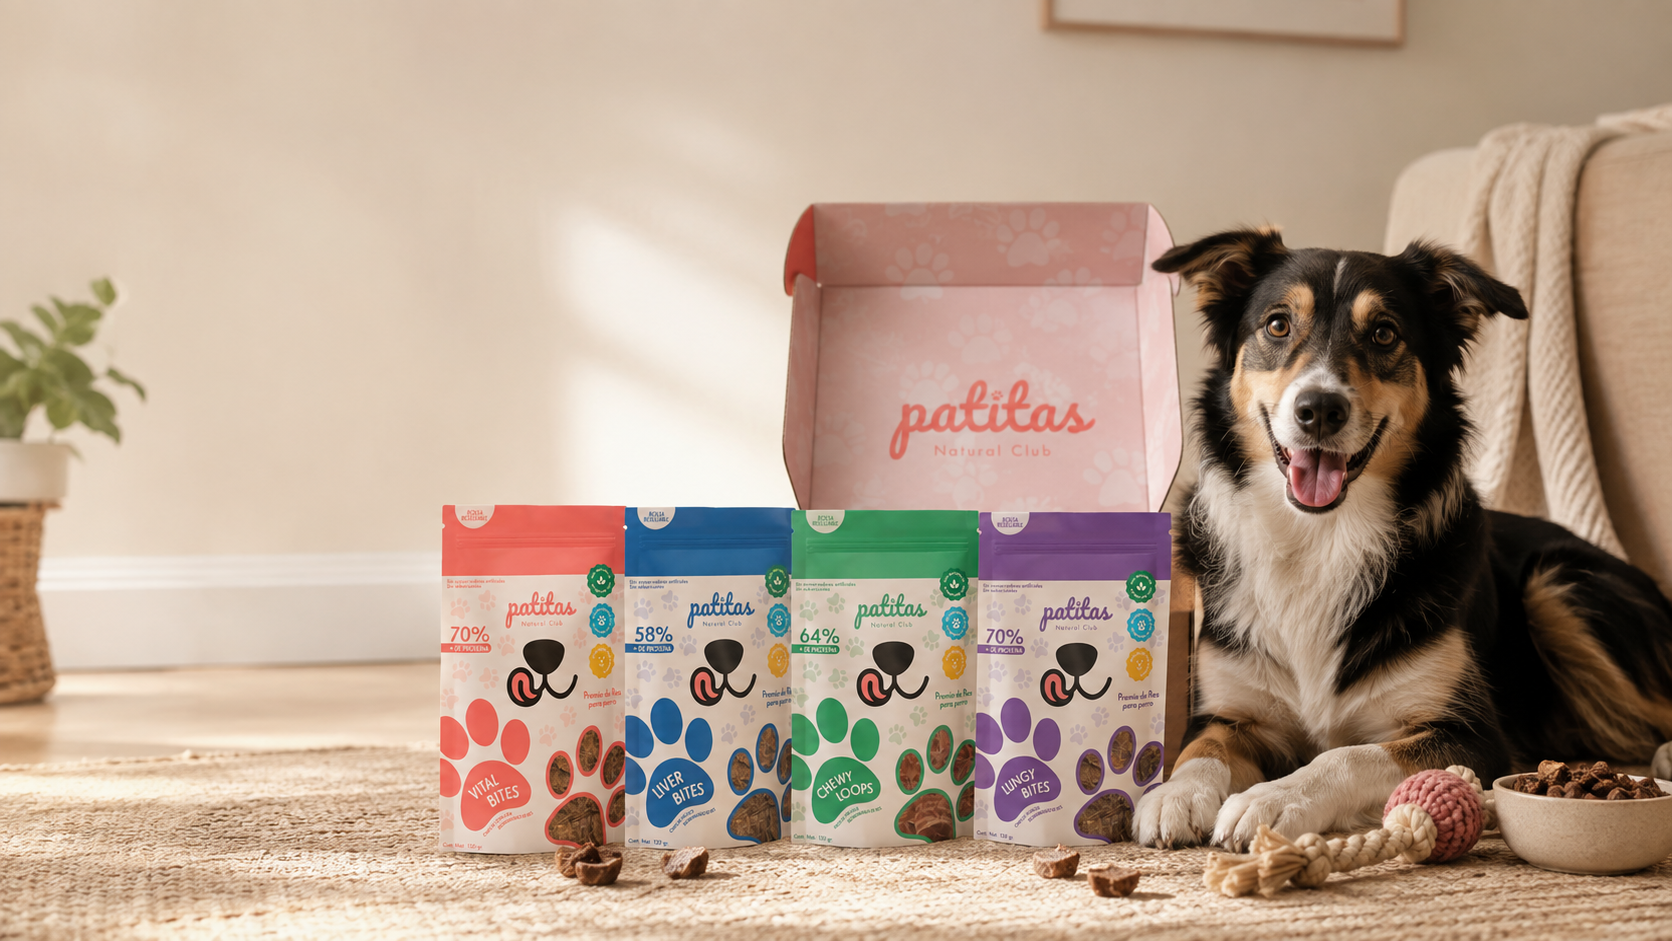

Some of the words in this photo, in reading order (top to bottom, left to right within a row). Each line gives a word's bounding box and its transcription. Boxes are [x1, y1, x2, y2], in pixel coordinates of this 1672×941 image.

[889, 379, 1096, 460] patitas
[934, 444, 1001, 457] Natural
[1011, 444, 1051, 457] Club
[505, 590, 577, 629] patitas
[686, 591, 755, 629] patitas
[854, 593, 927, 630] patitas
[1039, 596, 1113, 632] patitas
[450, 626, 490, 642] 70%
[634, 626, 673, 643] 58%
[799, 628, 840, 644] 64%
[985, 628, 1024, 645] 70%
[468, 774, 500, 800] VITAL
[651, 771, 685, 799] LIVER
[672, 782, 705, 806] BITES
[816, 770, 852, 799] CHEWY
[835, 782, 874, 802] LOOPS
[1000, 768, 1036, 796] LUNGY
[1020, 780, 1051, 799] BITES
[486, 785, 520, 808] BITES
